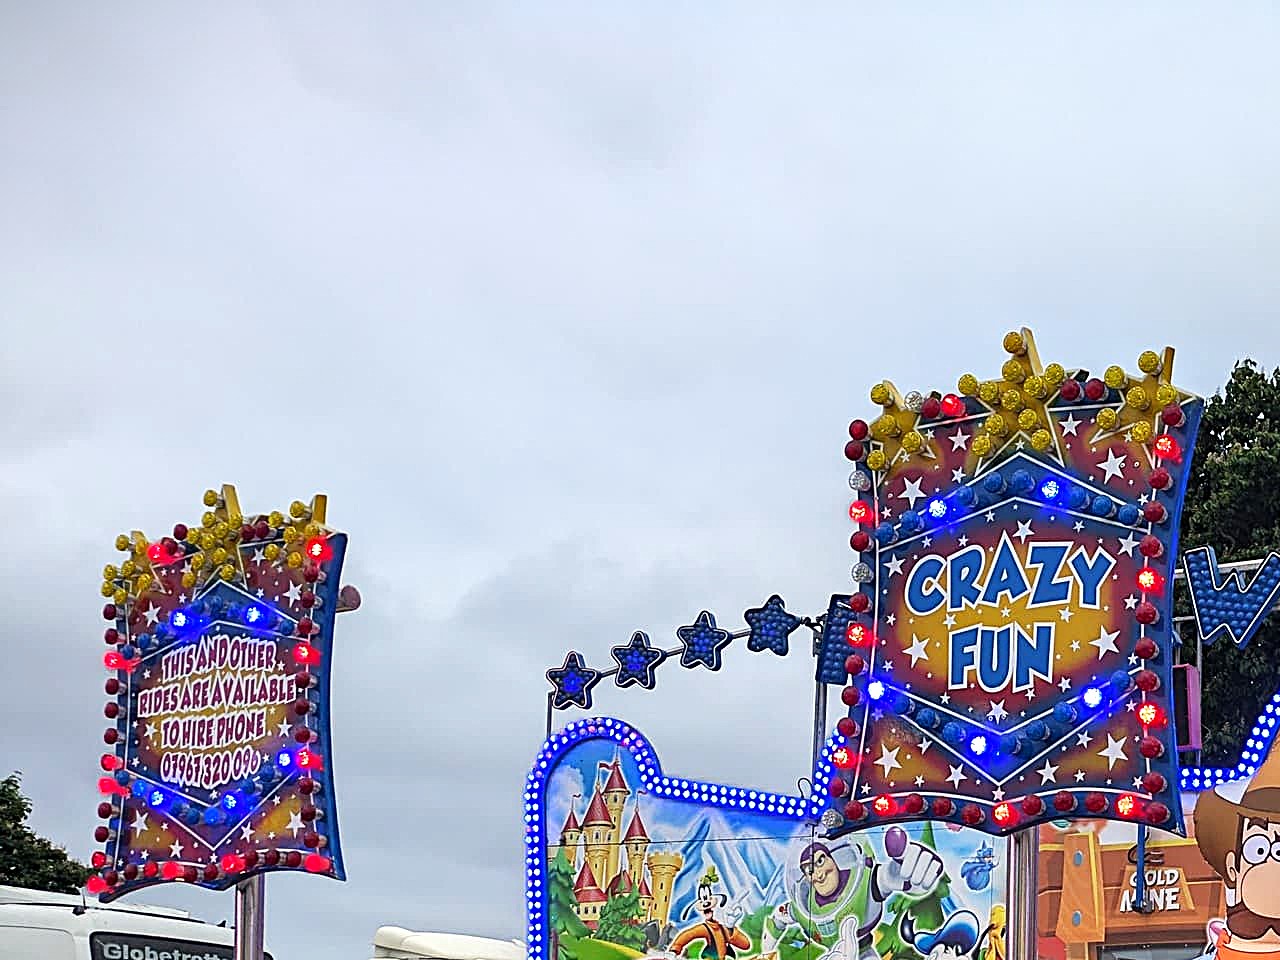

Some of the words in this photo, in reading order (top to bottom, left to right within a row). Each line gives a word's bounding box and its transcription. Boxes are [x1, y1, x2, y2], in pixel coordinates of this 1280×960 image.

[905, 530, 1117, 615] CRAZY
[162, 643, 197, 683] THIS
[195, 634, 228, 674] AND
[228, 637, 277, 672] OTHER
[948, 622, 1056, 693] FUN
[138, 682, 180, 717] RIDES
[180, 676, 212, 713] ARE
[211, 670, 297, 713] AVAILABLE
[161, 717, 181, 748] TO
[181, 714, 216, 750] HIRE
[216, 707, 267, 746] PHONE
[161, 751, 202, 787] 07967
[202, 750, 231, 789] 320
[1120, 888, 1179, 911] MNE
